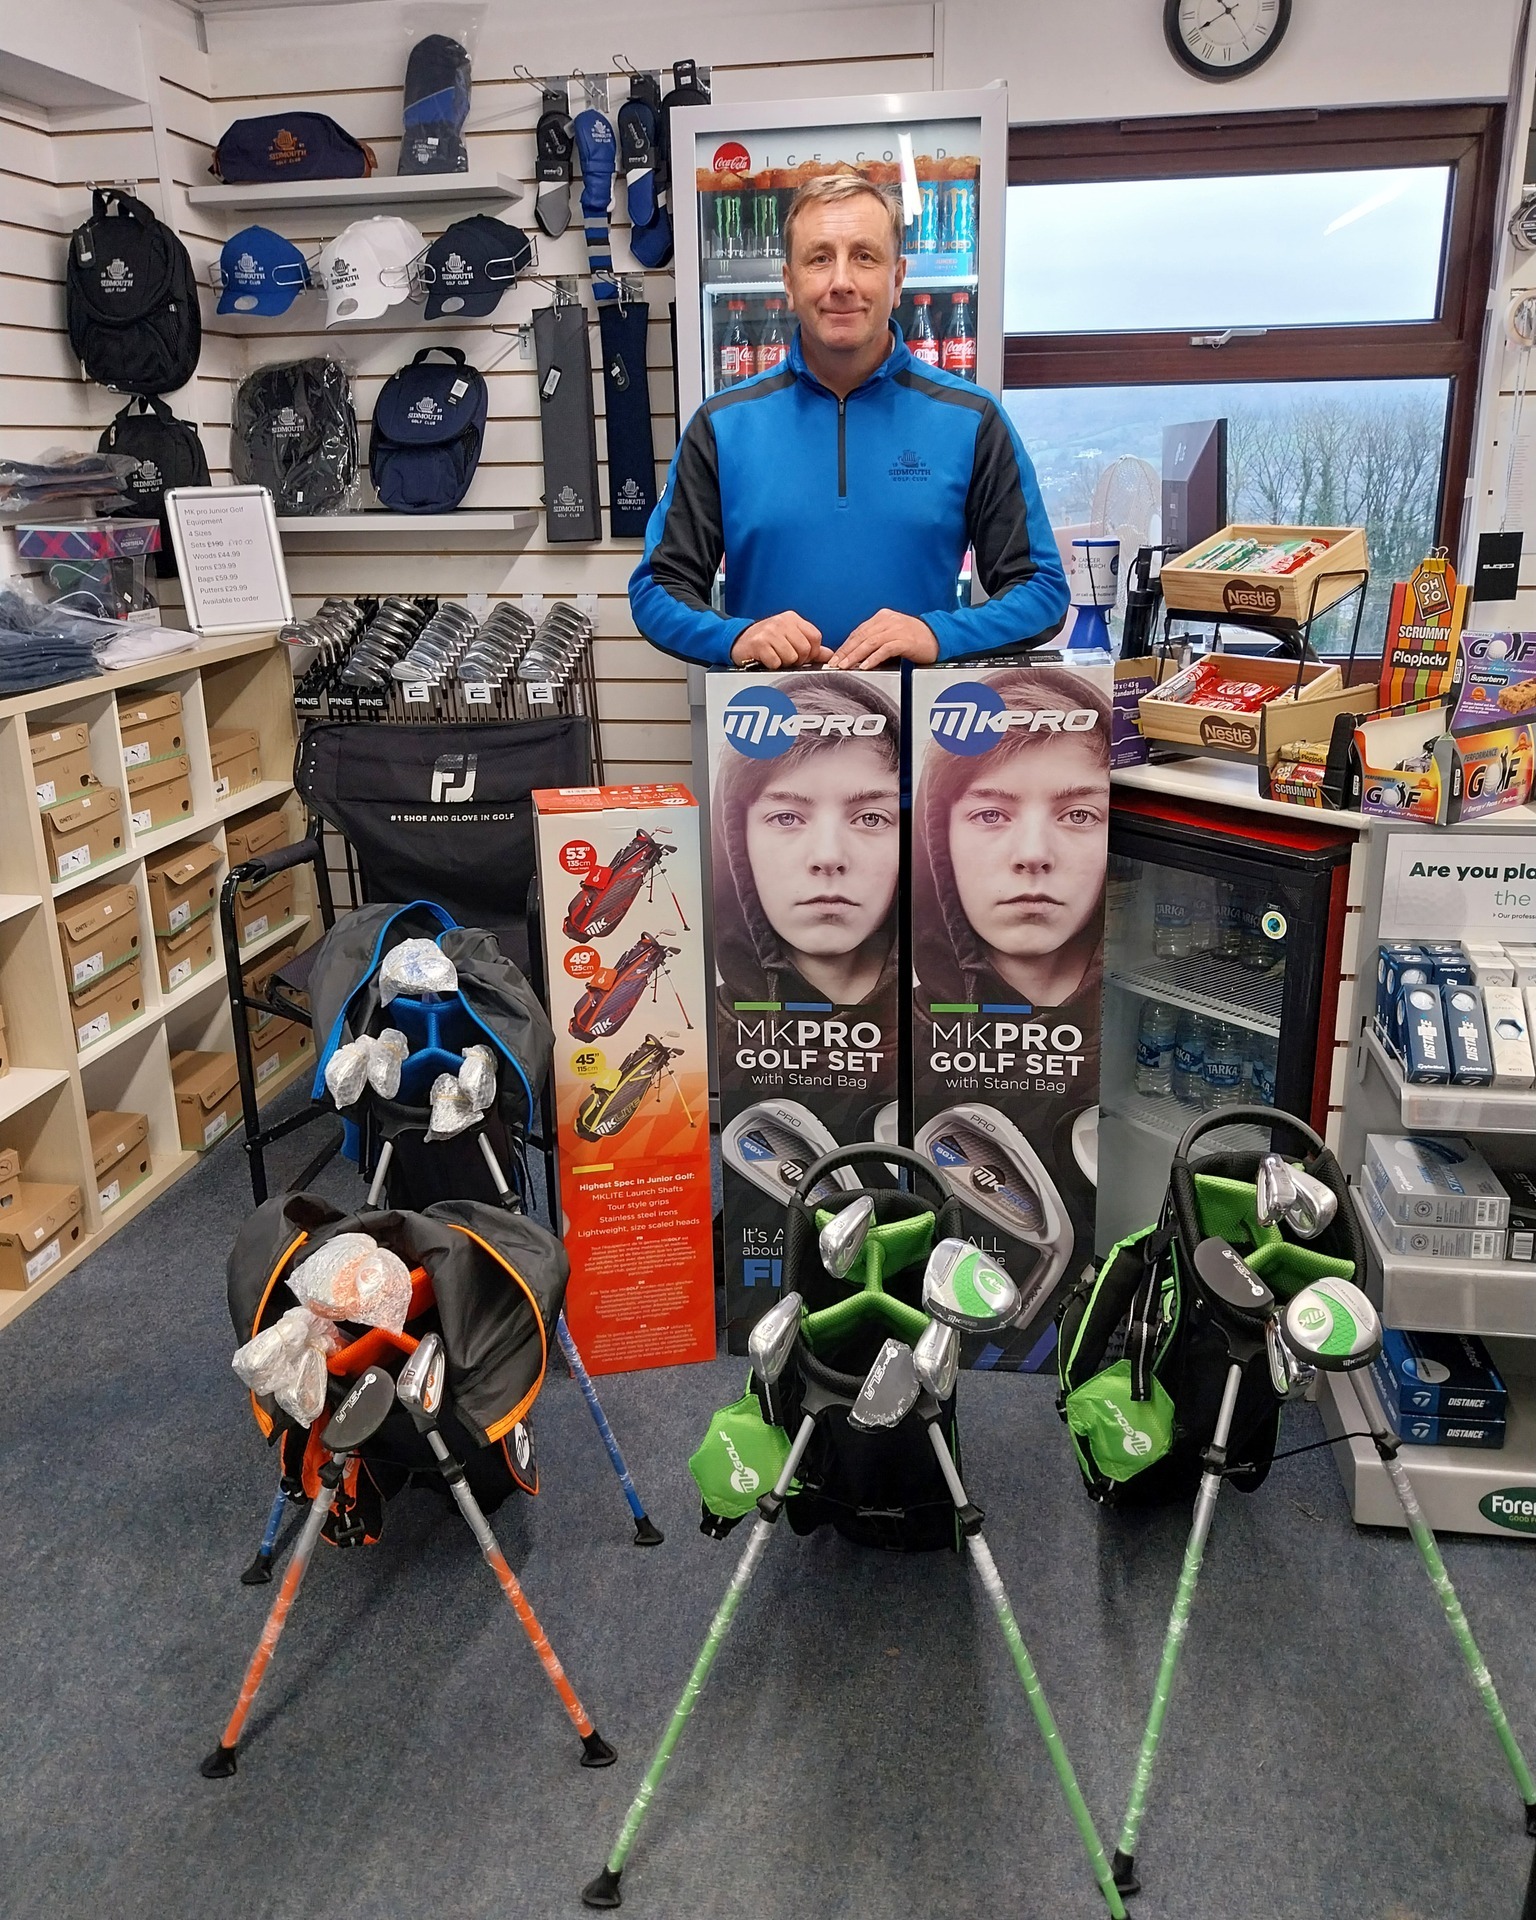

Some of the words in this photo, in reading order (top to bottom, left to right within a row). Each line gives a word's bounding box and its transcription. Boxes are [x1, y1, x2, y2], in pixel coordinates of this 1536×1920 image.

[268, 150, 307, 160] SIDMOUTH
[714, 156, 748, 170] Coca-Cola
[235, 272, 266, 280] SIDMOUTH
[332, 274, 360, 285] SIDMOUTH
[442, 272, 474, 280] SIDMOUTH
[407, 412, 443, 421] SIDMOUTH
[271, 425, 305, 433] SIDMOUTH
[132, 480, 163, 488] SIDMOUTH
[229, 506, 244, 514] Golf
[553, 505, 585, 513] SIDMOUTH
[186, 518, 223, 526] Equipment
[190, 541, 207, 549] Sets
[217, 550, 241, 558] £44.99
[213, 562, 237, 570] £39.99
[197, 575, 215, 583] Bags
[215, 573, 239, 581] £59.99
[225, 584, 248, 592] £29.99
[1419, 578, 1440, 593] OH
[202, 597, 233, 605] Available
[1423, 590, 1441, 605] SO
[1398, 625, 1451, 640] SCRUMMY
[1470, 674, 1507, 685] Superberry
[294, 697, 319, 706] PING
[328, 697, 353, 706] PING
[358, 698, 384, 707] PING
[723, 704, 888, 746] MKPRO
[929, 701, 1099, 742] MKPRO
[1463, 747, 1499, 762] PERFORMANCE
[1276, 766, 1291, 774] OH
[1364, 774, 1396, 783] PERFORMANCE
[1274, 783, 1317, 798] SCRUMMY
[1467, 804, 1482, 813] Energy
[1486, 800, 1498, 808] Focus
[390, 814, 402, 822] #1
[403, 815, 428, 823] SHOE
[450, 814, 479, 823] GLOVE
[480, 814, 491, 822] IN
[492, 812, 515, 822] GOLF
[1406, 812, 1435, 820] Performance
[1409, 861, 1451, 878] Are
[1456, 865, 1498, 882] you
[1494, 889, 1531, 907] the
[1156, 904, 1185, 917] TARKA
[1497, 912, 1510, 920] Our
[570, 964, 594, 972] 125cm
[736, 1018, 882, 1049] MKPRO
[931, 1021, 1084, 1052] MKPRO
[735, 1049, 818, 1070] GOLF
[828, 1051, 884, 1073] SET
[929, 1052, 1015, 1074] GOLF
[1025, 1054, 1085, 1077] SET
[577, 1065, 599, 1073] 115cm
[1207, 1063, 1239, 1076] TARKA
[751, 1072, 784, 1086] with
[788, 1073, 833, 1087] Stand
[837, 1076, 868, 1090] Bag
[945, 1076, 979, 1090] with
[984, 1077, 1030, 1092] Stand
[1034, 1080, 1067, 1094] Bag
[594, 1096, 641, 1135] MKLITE
[775, 1109, 802, 1128] PRO
[970, 1114, 997, 1133] PRO
[580, 1181, 612, 1191] Highest
[613, 1179, 635, 1188] Spec
[646, 1174, 673, 1184] Junior
[674, 1172, 695, 1181] Golf:
[592, 1191, 624, 1201] MKLITE
[626, 1188, 656, 1198] Launch
[658, 1185, 684, 1193] Shafts
[607, 1203, 626, 1211] Tour
[627, 1200, 647, 1209] style
[648, 1198, 670, 1207] grips
[599, 1213, 636, 1223] Stainless
[637, 1210, 657, 1219] steel
[658, 1209, 679, 1217] irons
[577, 1226, 629, 1238] Lightweight,
[630, 1222, 646, 1231] size
[648, 1220, 675, 1229] scaled
[676, 1217, 700, 1226] heads
[743, 1227, 768, 1244] It's
[966, 1236, 1006, 1254] ALL
[1447, 1397, 1485, 1408] DISTANCE
[1446, 1428, 1484, 1438] DISTANCE
[719, 1430, 754, 1494] MKGOLF
[1508, 1515, 1529, 1523] GOOD
